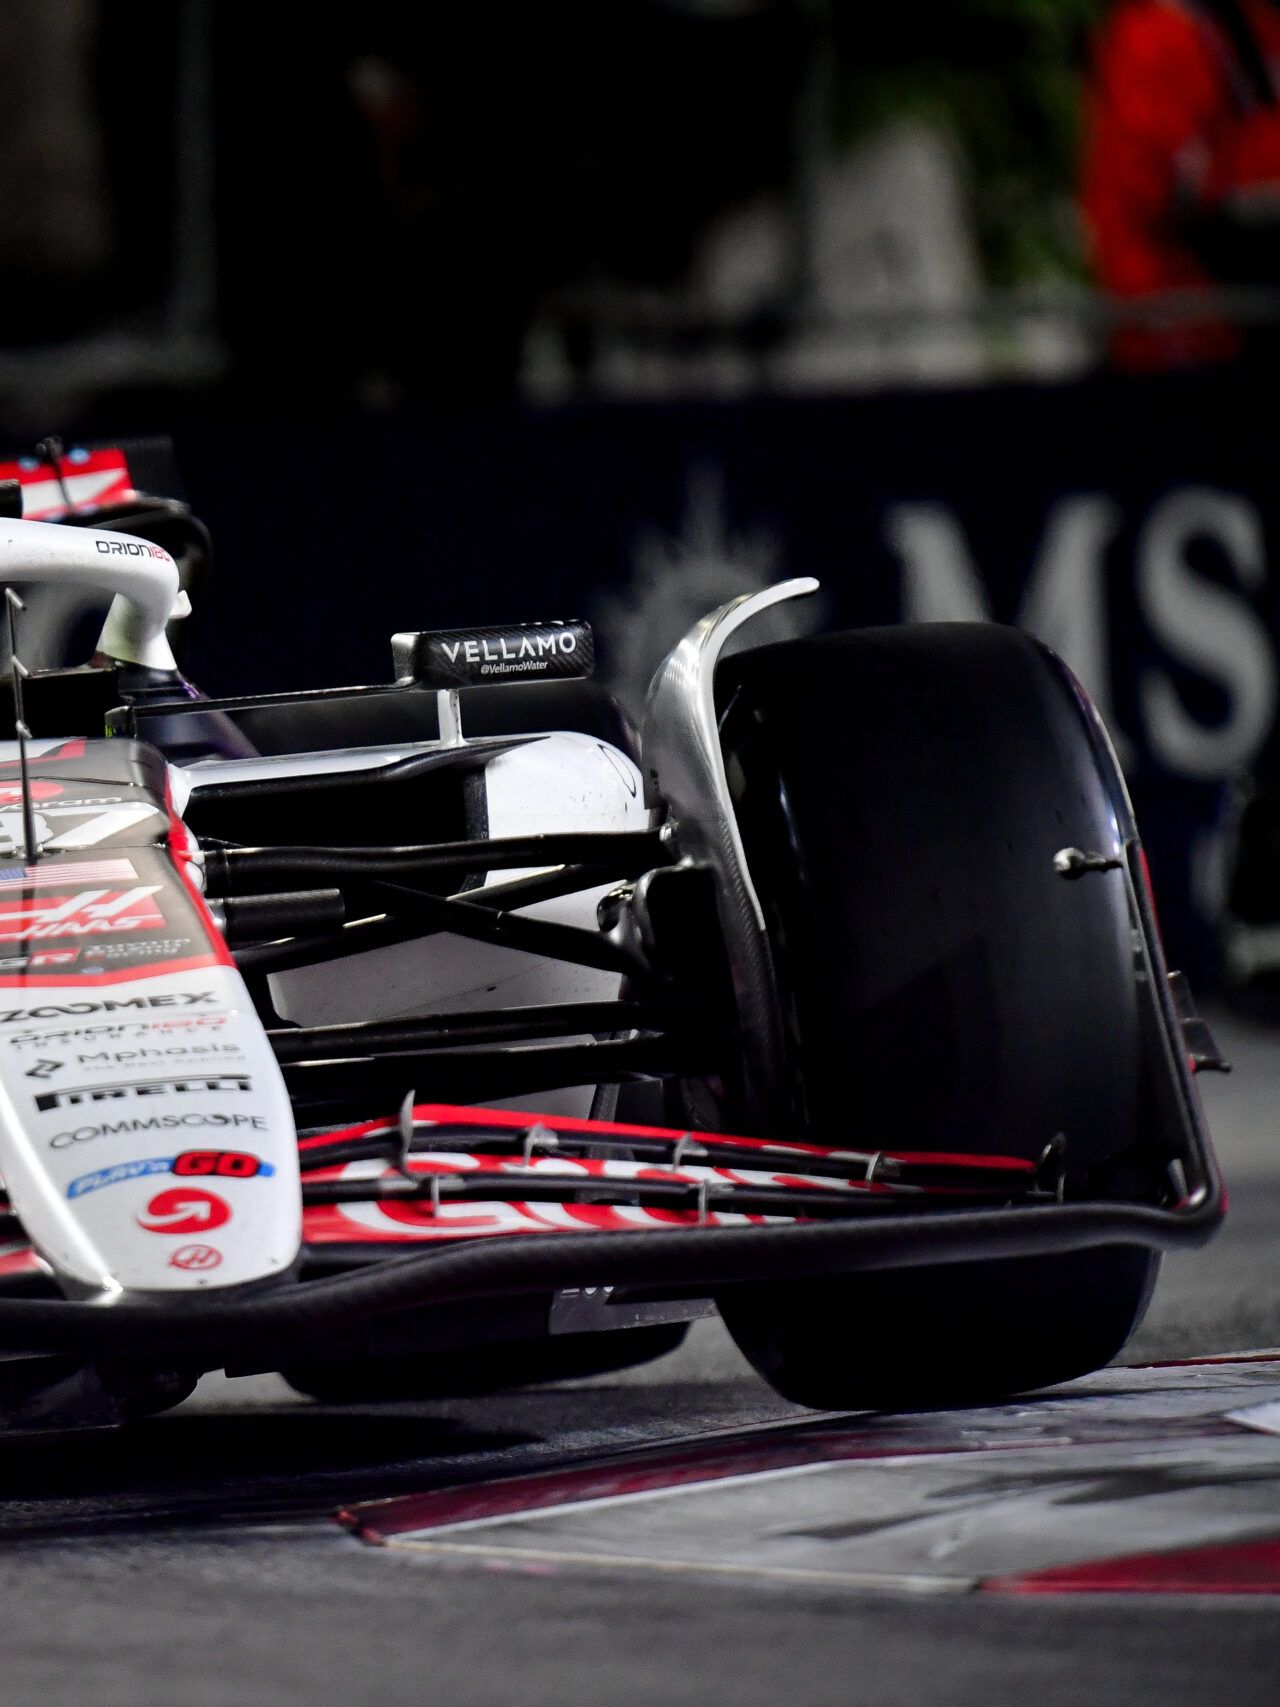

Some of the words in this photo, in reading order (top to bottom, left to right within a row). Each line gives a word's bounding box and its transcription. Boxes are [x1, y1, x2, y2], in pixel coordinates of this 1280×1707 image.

[441, 631, 576, 663] VELLAMO
[480, 660, 548, 675] @VellamoWater
[77, 1041, 240, 1064] Mphasis
[34, 1073, 252, 1112] PIRELLI
[49, 1113, 269, 1149] COMMSCOPE
